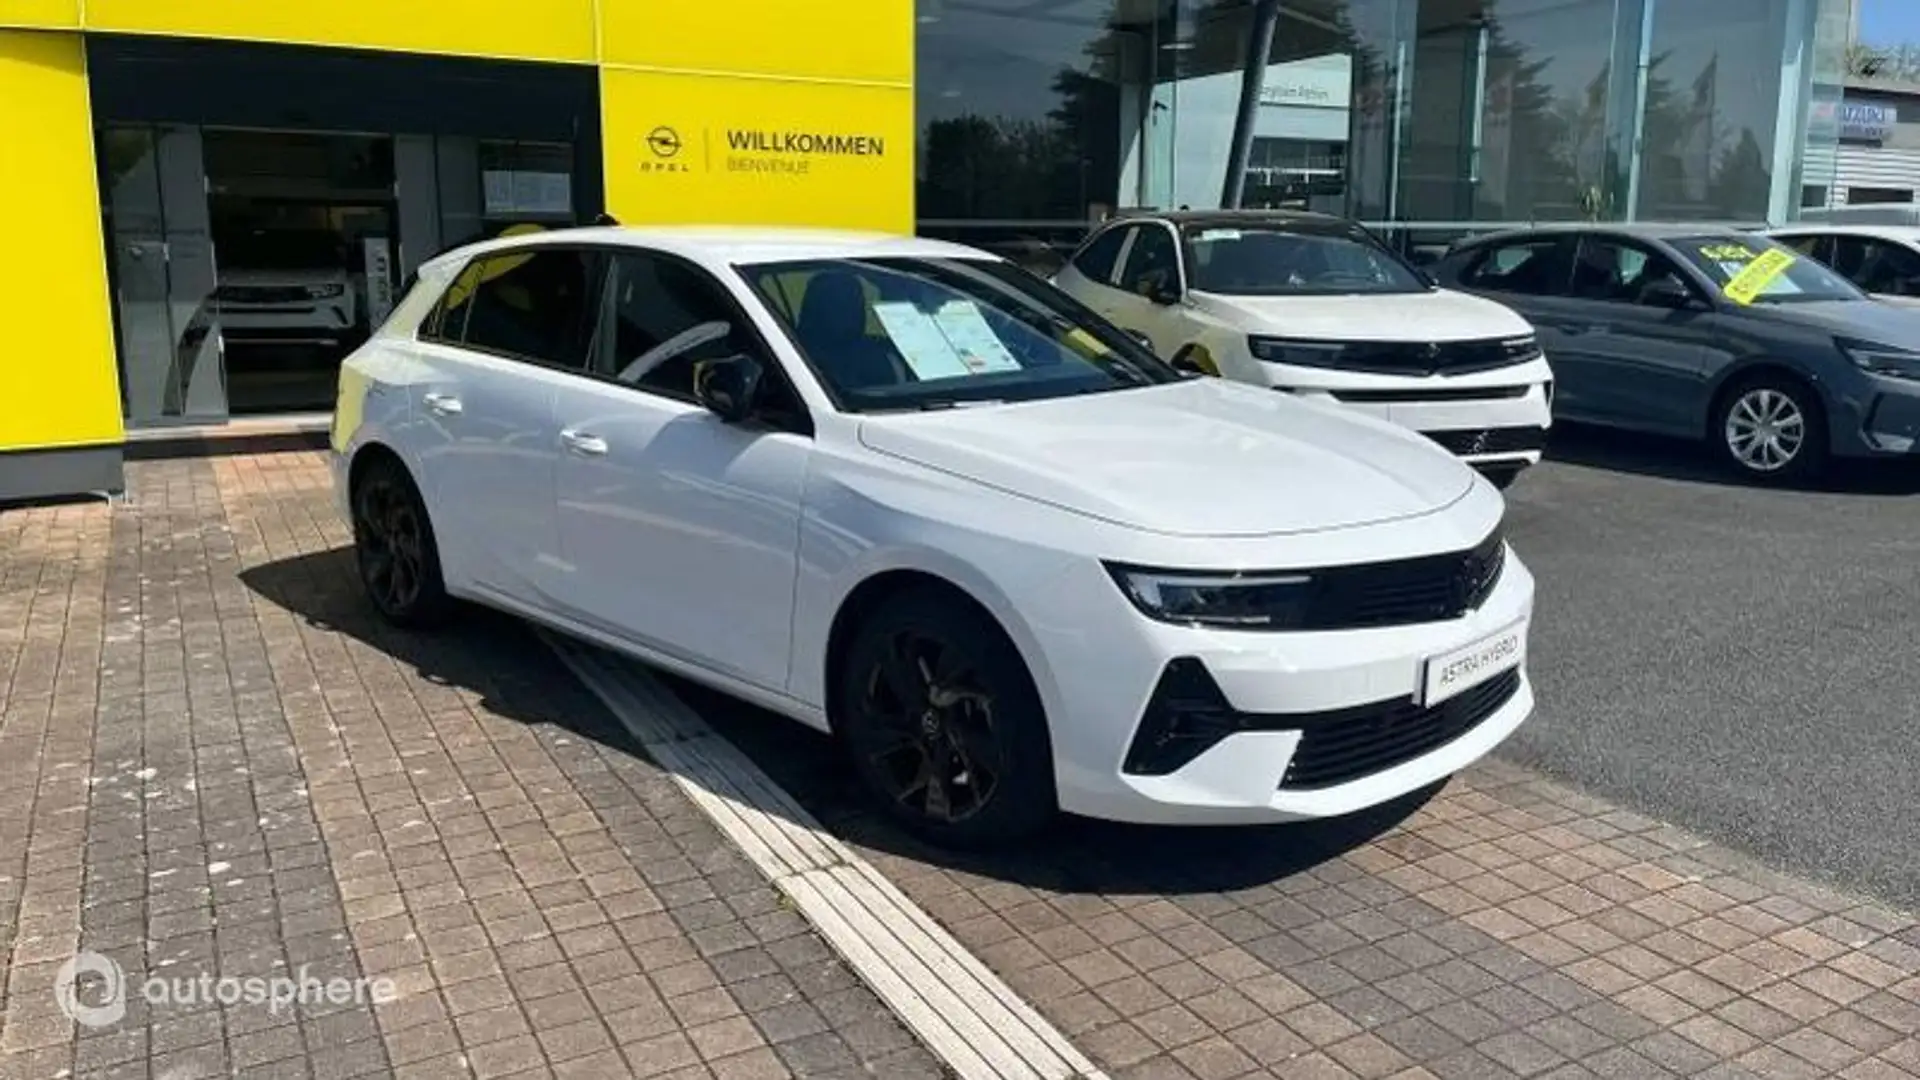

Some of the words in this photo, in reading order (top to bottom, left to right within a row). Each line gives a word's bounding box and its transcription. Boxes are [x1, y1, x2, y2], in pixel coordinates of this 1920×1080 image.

[727, 129, 885, 156] WILLKOMMEN
[640, 162, 690, 173] OPEL
[727, 156, 809, 175] BIENVENUE
[1440, 653, 1479, 686] ASTRA
[1481, 635, 1519, 666] HYBRID
